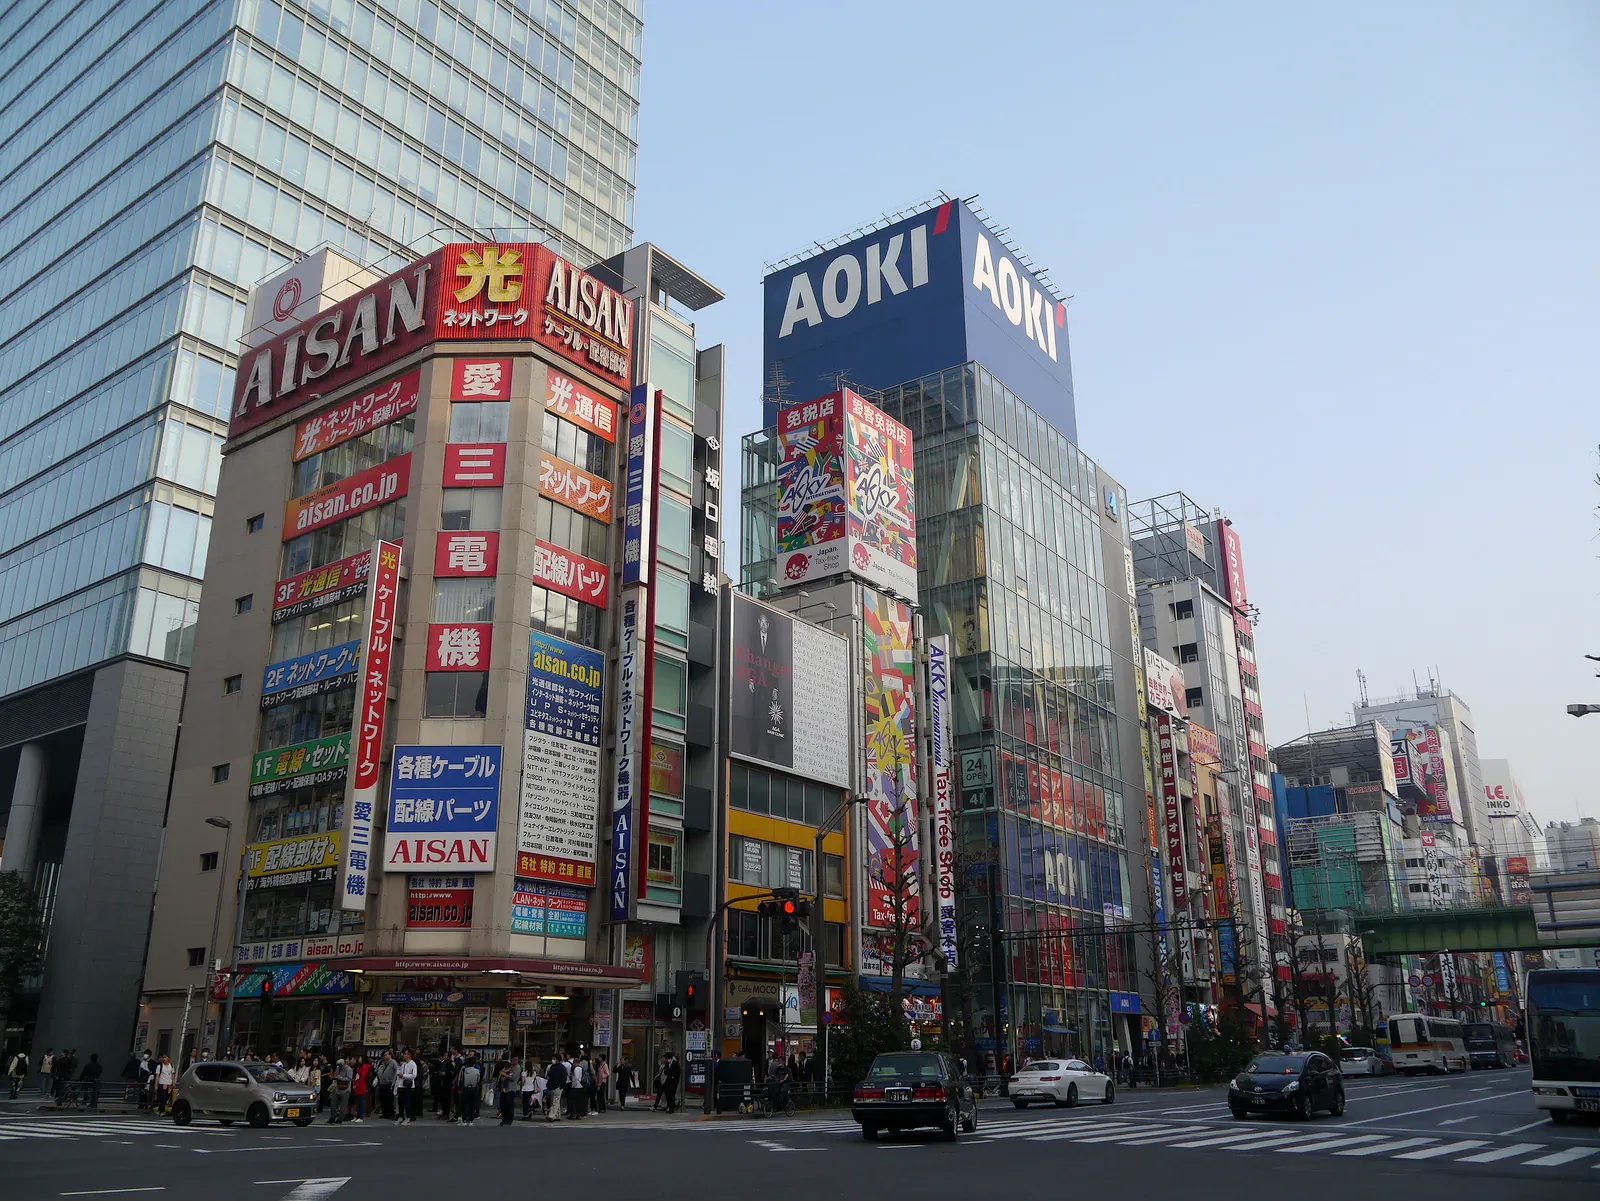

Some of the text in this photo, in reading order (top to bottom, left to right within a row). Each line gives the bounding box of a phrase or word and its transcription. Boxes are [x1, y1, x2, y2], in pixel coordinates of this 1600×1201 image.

[454, 247, 523, 303] 光
[778, 224, 929, 338] AOKI
[546, 258, 632, 349] AISAN
[972, 232, 1058, 363] AOKI
[443, 309, 529, 327] ネットワーク
[234, 263, 431, 418] AISAN
[462, 363, 502, 397] 愛
[546, 376, 612, 433] 光通信
[786, 399, 835, 430] 免税店
[455, 448, 494, 481] 三
[297, 472, 398, 530] aisan.co.jp
[540, 460, 611, 513] ネットワーク
[625, 434, 644, 566] 愛三電機
[806, 487, 841, 501] INTERNATIONAL
[703, 466, 720, 596] 坂口電熱
[878, 504, 908, 526] INTERNATIONAL
[449, 536, 488, 572] 電
[533, 545, 606, 597] 配線パーツ
[815, 554, 840, 566] Tax-free
[824, 561, 840, 571] Shop
[1228, 534, 1242, 604] カラオケ
[277, 581, 296, 603] 3F
[359, 551, 396, 777] 光・ケーブル・ネットワーク
[438, 627, 481, 667] 機
[266, 668, 284, 689] 2F
[533, 650, 601, 689] aisan.co.jp
[616, 599, 636, 801] 各種ケーブル・ネットワーク機器
[256, 737, 351, 777] 1F 電線・セット
[397, 754, 496, 780] 各種ケーブル
[930, 643, 954, 900] AKKY INTERNATIONAL Tax-free Shop
[966, 771, 988, 781] OPEN
[394, 798, 492, 823] 配線パーツ
[263, 836, 340, 873] 配線部材・
[346, 800, 371, 896] 愛三電機
[389, 839, 490, 863] AISAN
[613, 813, 628, 909] AISAN
[521, 856, 537, 872] 各社
[540, 859, 556, 875] 特約
[559, 862, 574, 877] 在庫
[410, 892, 453, 900] http://www.
[410, 900, 473, 925] aisan.co.jp
[395, 961, 469, 969] http://www.aisan.co.jp
[424, 992, 444, 1001] 1949
[738, 985, 777, 994] Cafe MOCO
